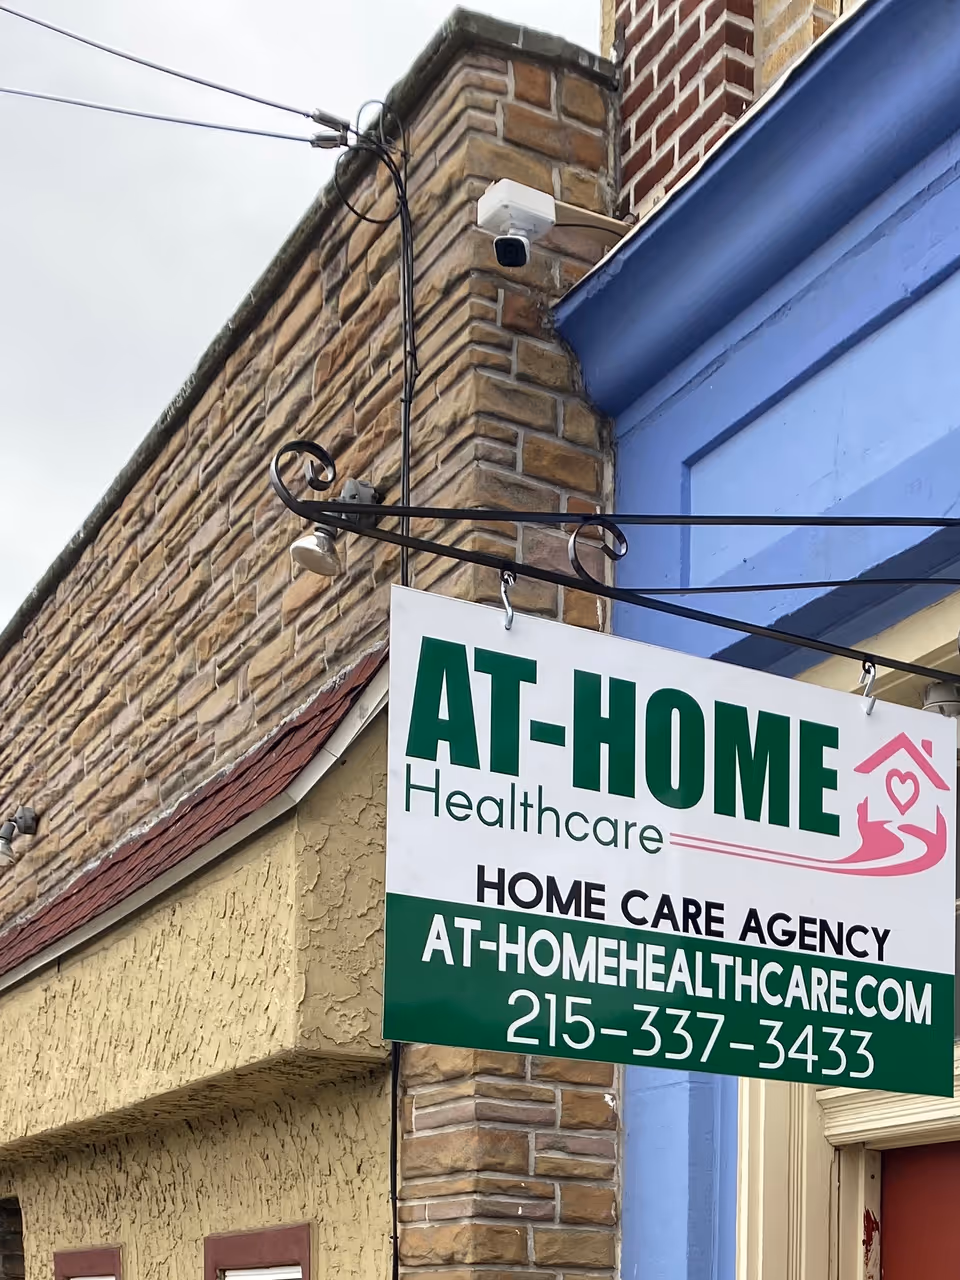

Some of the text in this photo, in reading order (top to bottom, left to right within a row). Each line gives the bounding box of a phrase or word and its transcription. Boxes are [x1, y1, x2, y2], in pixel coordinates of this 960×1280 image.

[405, 635, 841, 838] AT-HOME
[405, 763, 664, 855] Healthcare
[476, 864, 892, 962] HOME CARE AGENCY
[421, 913, 933, 1025] AT-HOMEHEALTHCARE.COM
[506, 989, 875, 1079] 215-337-3433
